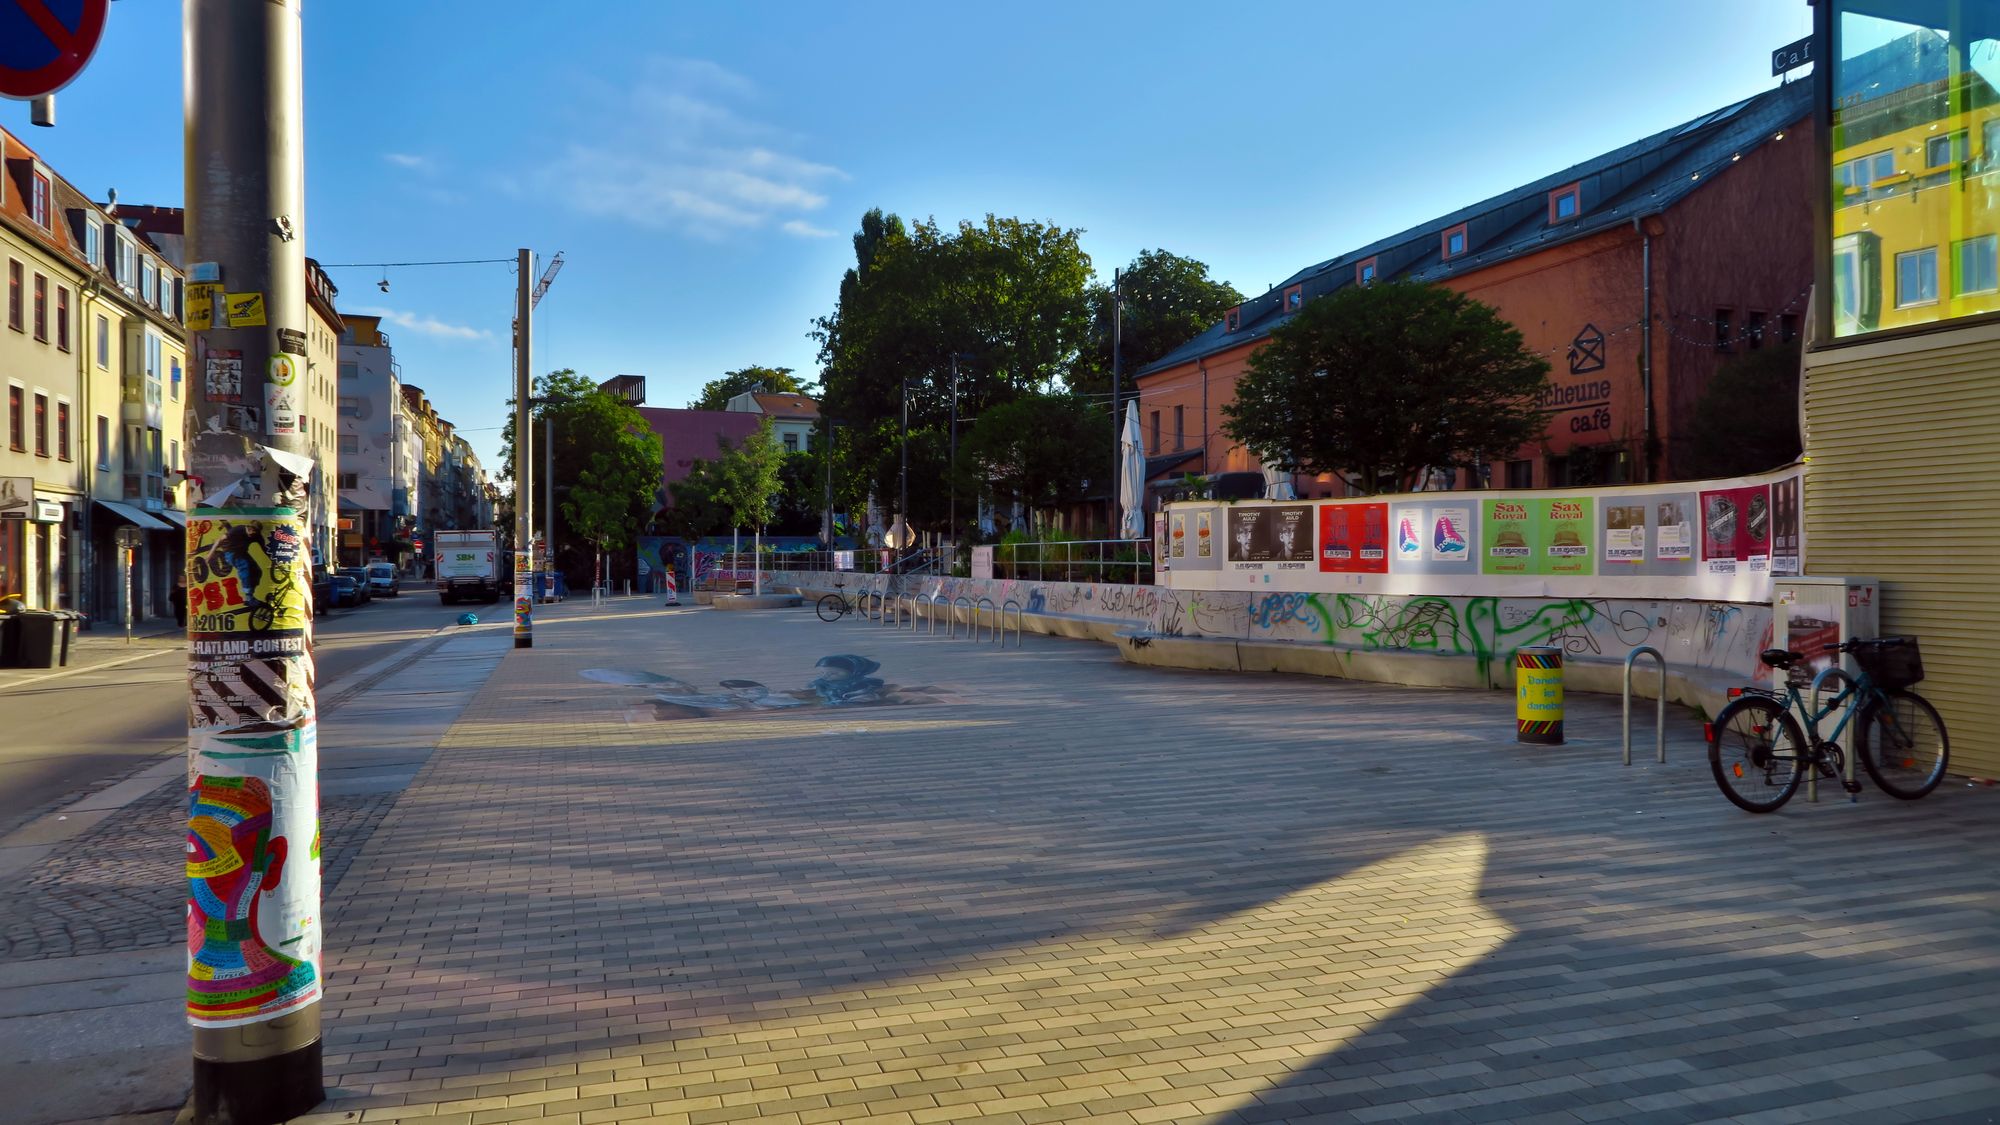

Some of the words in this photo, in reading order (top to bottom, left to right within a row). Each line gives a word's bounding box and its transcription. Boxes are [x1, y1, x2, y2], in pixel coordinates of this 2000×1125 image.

[1570, 406, 1611, 433] café
[1495, 502, 1525, 513] Sax
[1551, 501, 1582, 512] Sax
[1493, 511, 1528, 521] Royal
[1549, 511, 1584, 521] Royal
[455, 553, 475, 562] SBH
[188, 576, 244, 616] PSI
